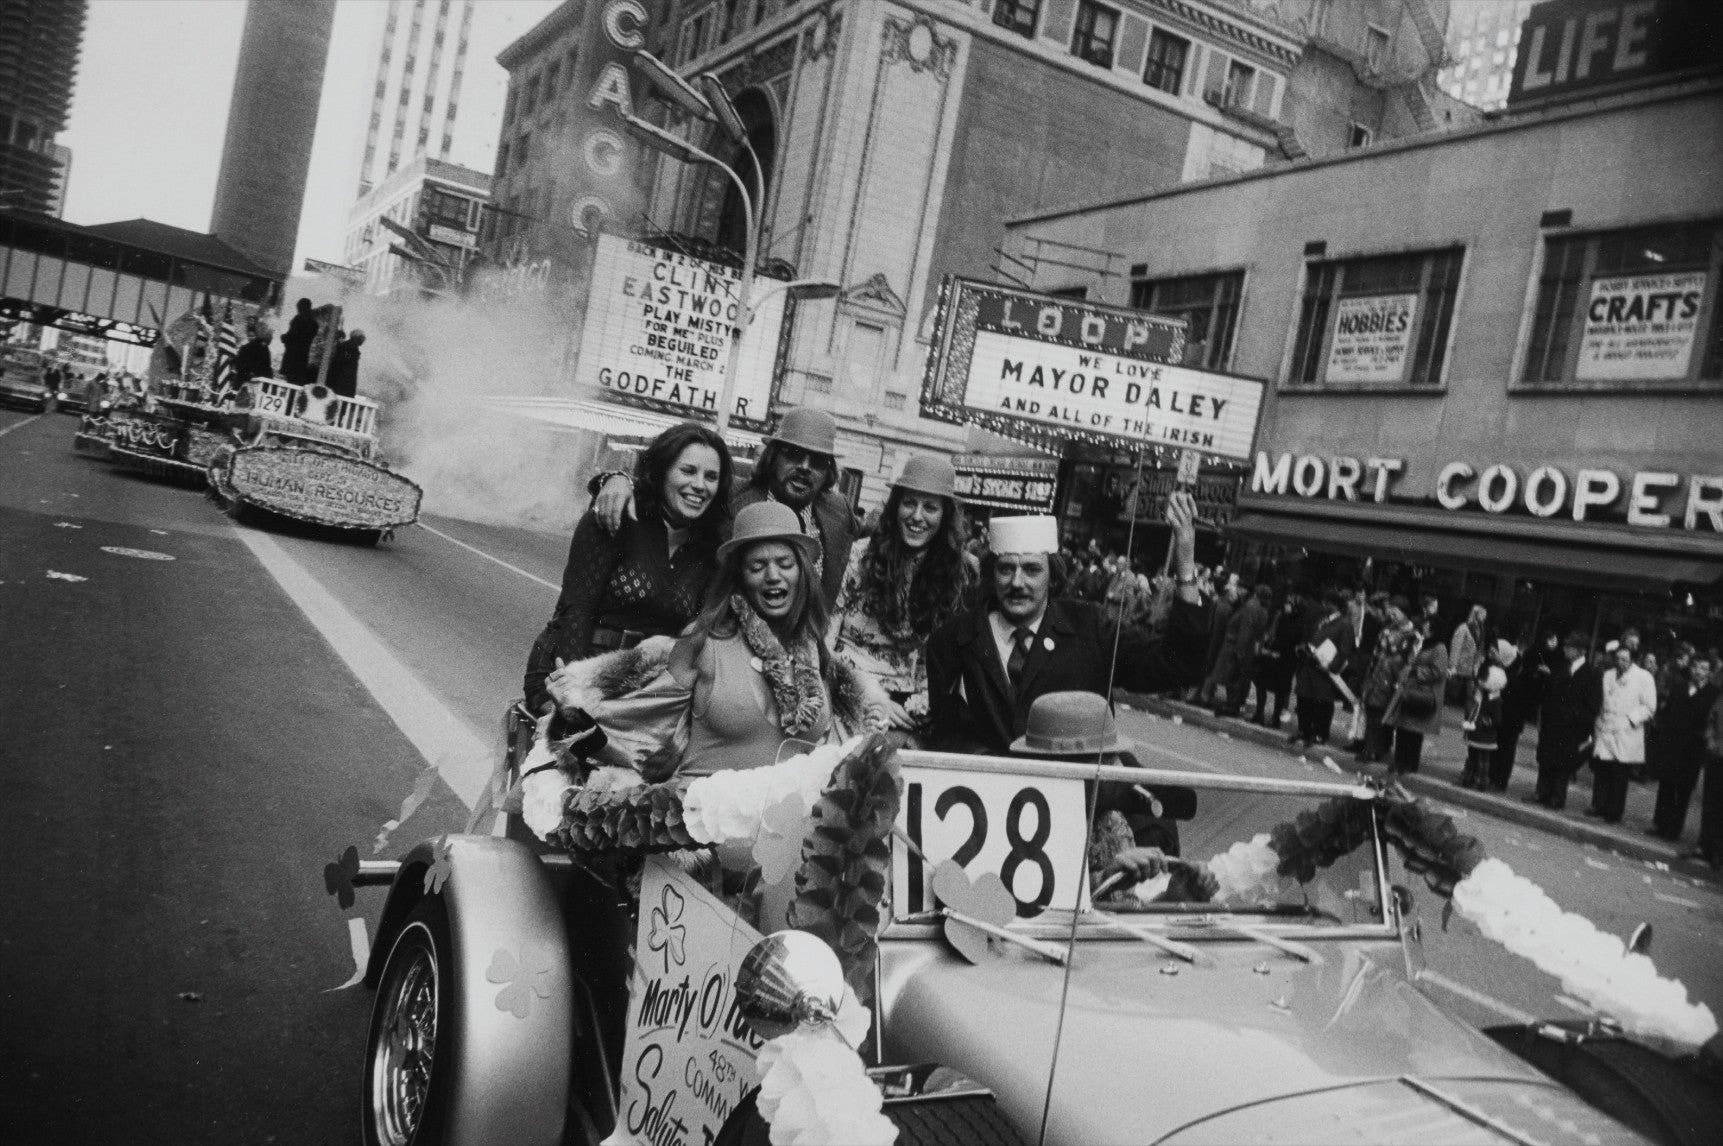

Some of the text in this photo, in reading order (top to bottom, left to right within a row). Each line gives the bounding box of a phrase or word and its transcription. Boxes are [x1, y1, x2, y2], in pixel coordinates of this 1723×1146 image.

[1522, 0, 1656, 92] LIFE
[678, 255, 685, 266] 2
[654, 262, 735, 298] CLINT
[1337, 309, 1410, 335] HOBBIES
[1588, 289, 1701, 323] CRAFTS
[645, 319, 668, 334] FOR
[697, 332, 725, 348] PLUS
[687, 315, 732, 338] MISTY
[1001, 300, 1150, 351] LOOP
[629, 344, 672, 363] COMING
[676, 355, 714, 373] MARCH
[1078, 353, 1164, 382] WE LOVE
[258, 394, 283, 412] 129
[1000, 358, 1229, 421] MAYOR DALEY
[1001, 396, 1215, 448] AND ALL OF THE IRISH
[246, 471, 305, 494] HUMAN
[314, 484, 402, 512] RESOURCES
[1251, 450, 1406, 503] MORT
[1436, 461, 1723, 533] COOPER
[907, 782, 1055, 918] 128
[637, 974, 698, 1044] Marty
